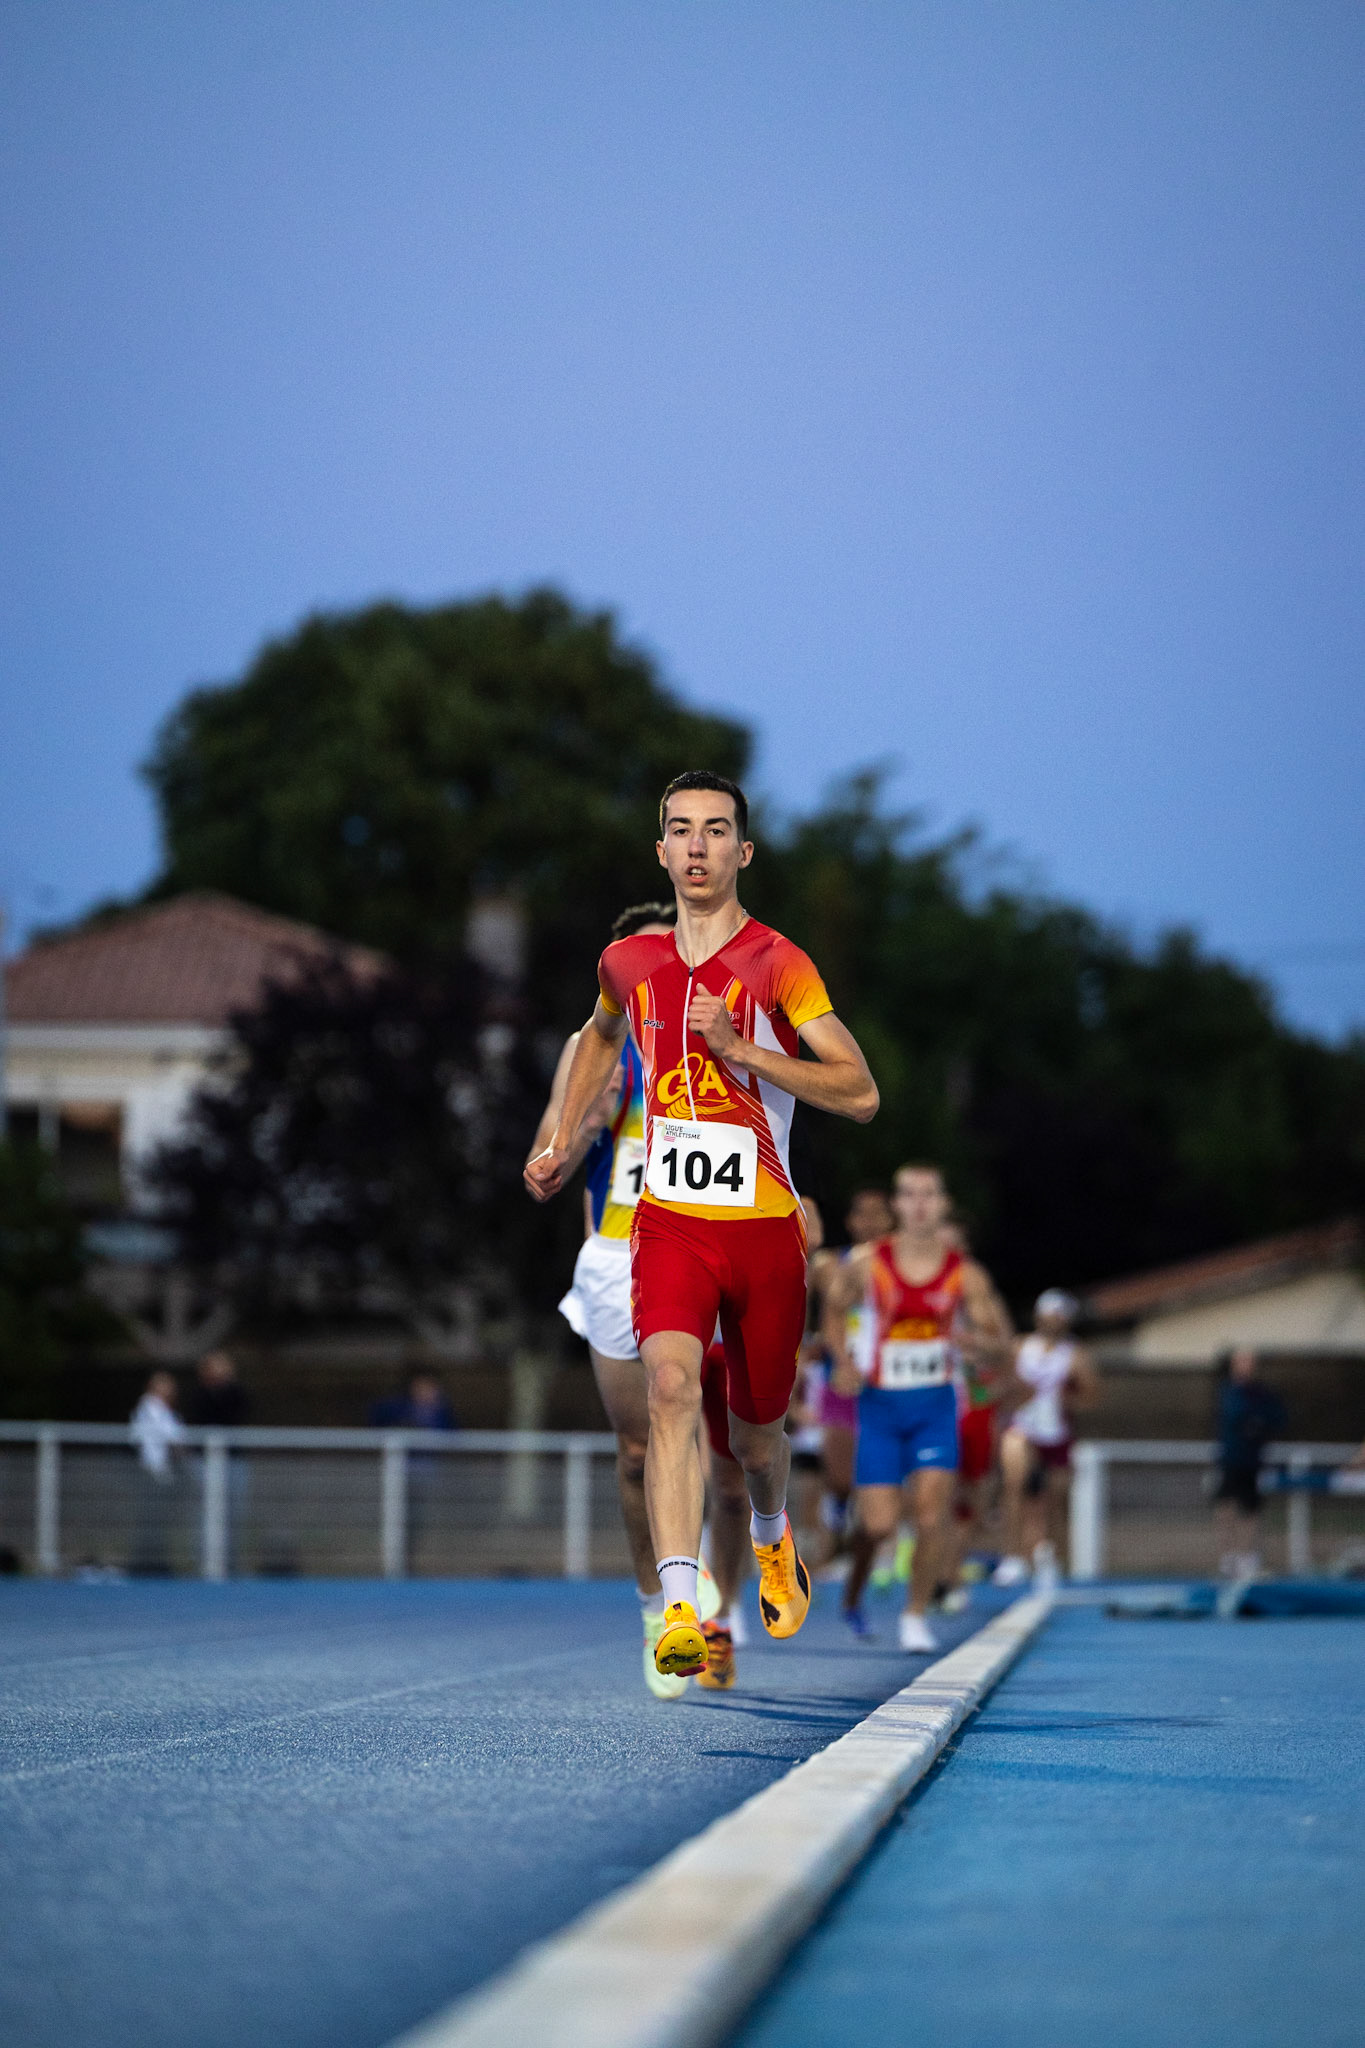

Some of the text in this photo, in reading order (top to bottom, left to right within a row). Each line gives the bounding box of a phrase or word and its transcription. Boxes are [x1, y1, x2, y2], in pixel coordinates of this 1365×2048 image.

[643, 1019, 664, 1029] POLI
[665, 1124, 684, 1133] LIGUE
[665, 1130, 701, 1140] ATHLETISME
[662, 1147, 744, 1192] 104
